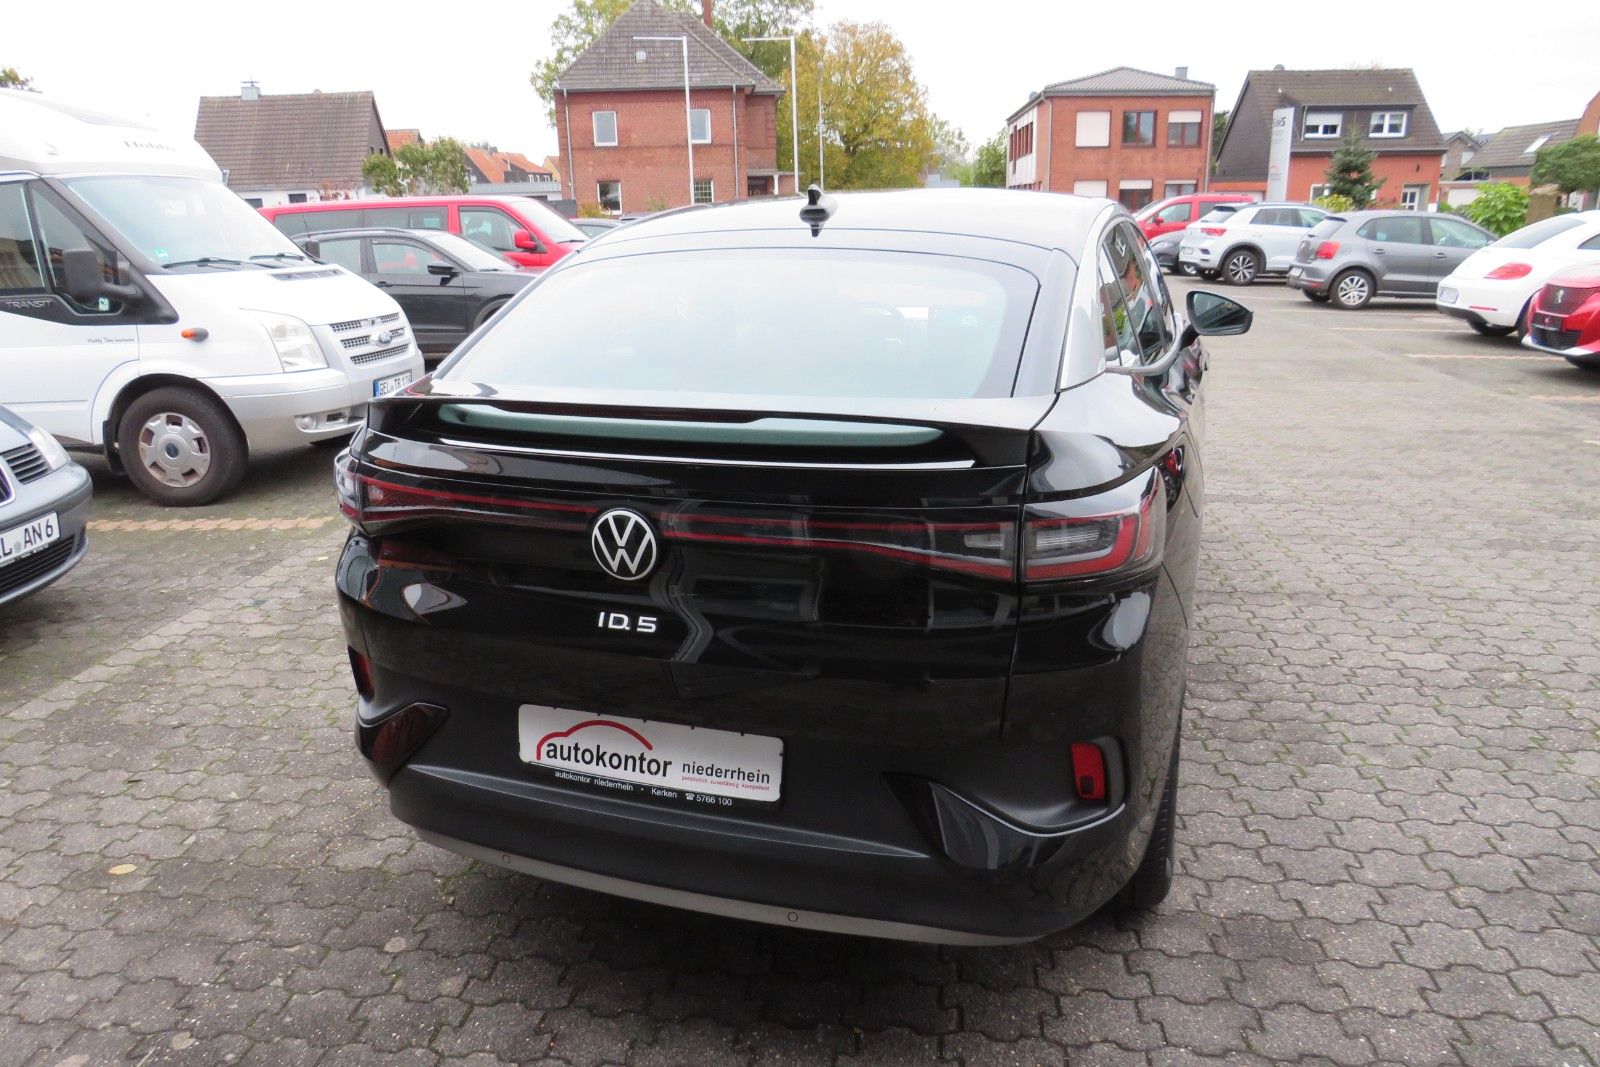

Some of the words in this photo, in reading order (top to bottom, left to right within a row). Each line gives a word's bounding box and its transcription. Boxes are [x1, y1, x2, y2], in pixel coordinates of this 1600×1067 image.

[5, 300, 52, 309] TRANSIT
[24, 523, 43, 548] AN
[45, 518, 53, 537] 6
[592, 511, 656, 580] VW
[546, 741, 672, 777] autokontor
[682, 761, 770, 784] niederrhein
[554, 770, 591, 785] autokontor
[594, 778, 634, 792] niederrhein
[651, 787, 678, 799] Kerken
[695, 793, 716, 804] 5766
[718, 797, 732, 806] 100
